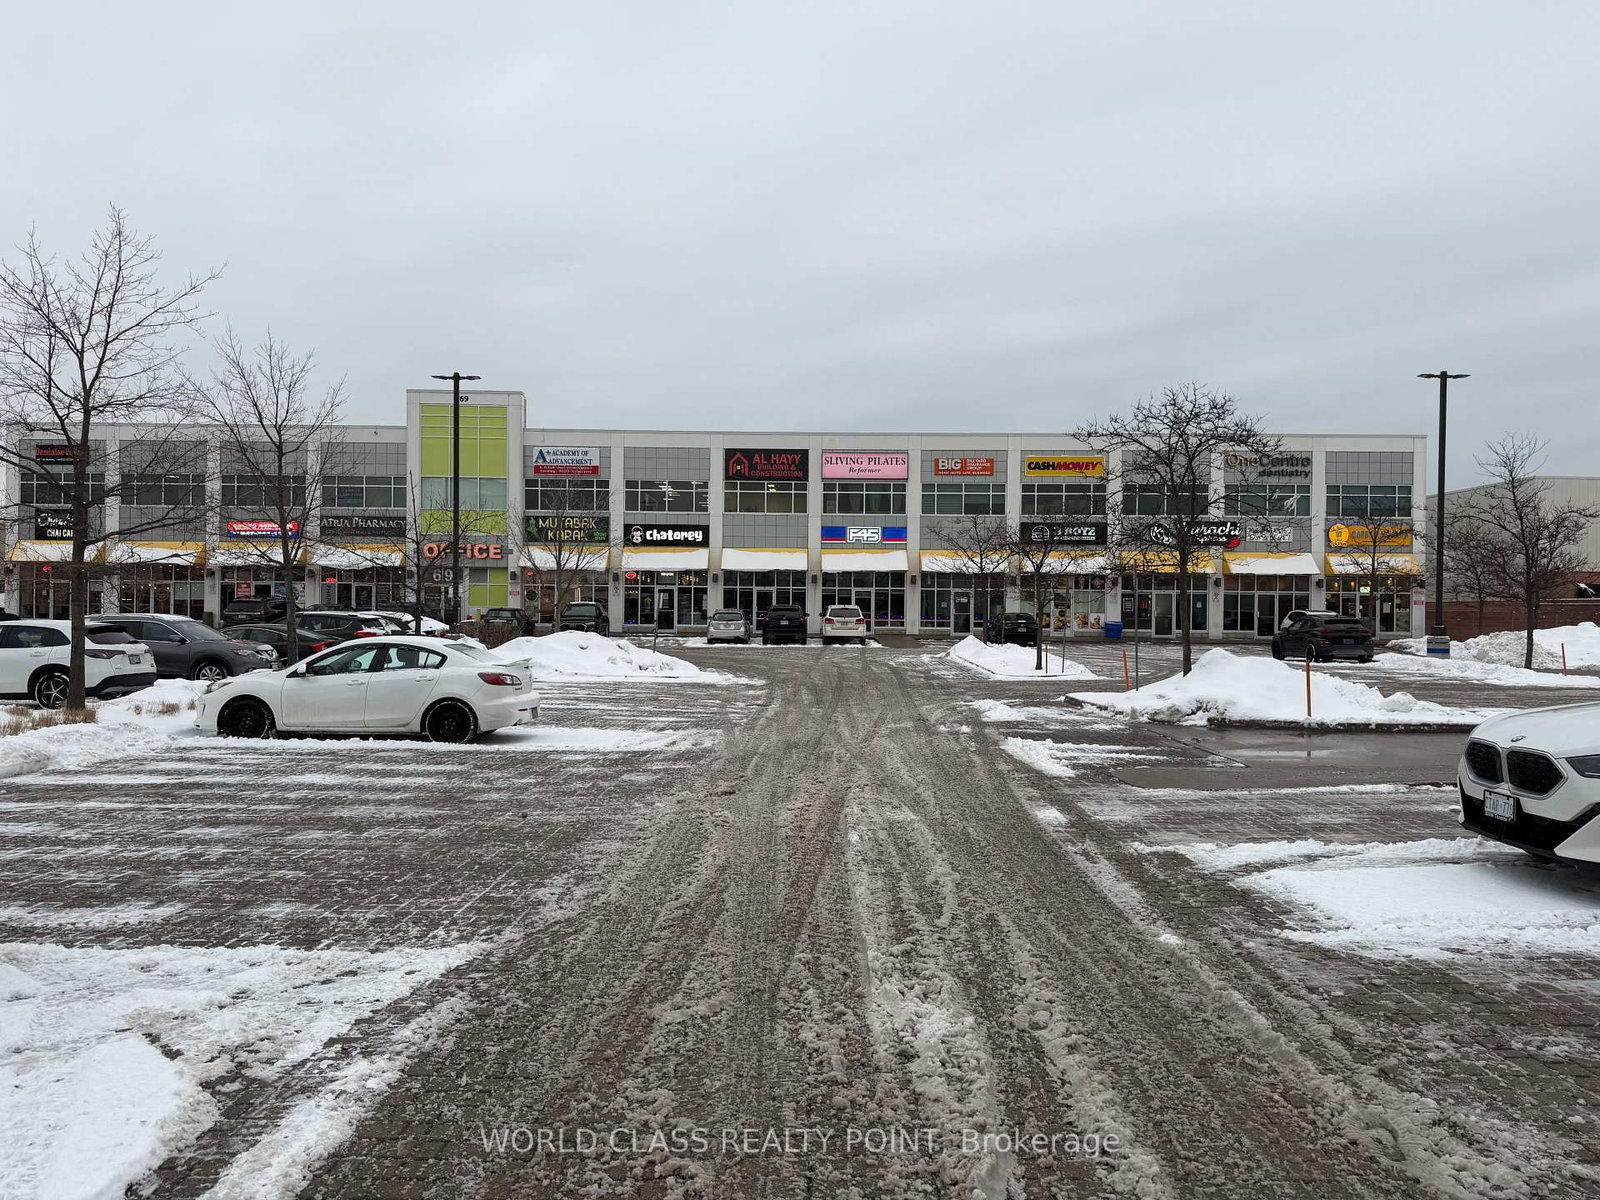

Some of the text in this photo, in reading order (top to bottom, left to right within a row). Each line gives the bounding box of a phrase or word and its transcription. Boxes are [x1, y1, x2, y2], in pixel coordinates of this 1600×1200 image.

[753, 454, 801, 464] AL HAYY
[824, 456, 906, 465] SLIVING PILATES
[938, 458, 962, 470] BIG
[1258, 469, 1310, 478] dentistry
[320, 517, 406, 527] ATRIA PHARMACY
[848, 526, 881, 543] F45
[1176, 522, 1243, 536] arachi
[433, 569, 453, 582] 69
